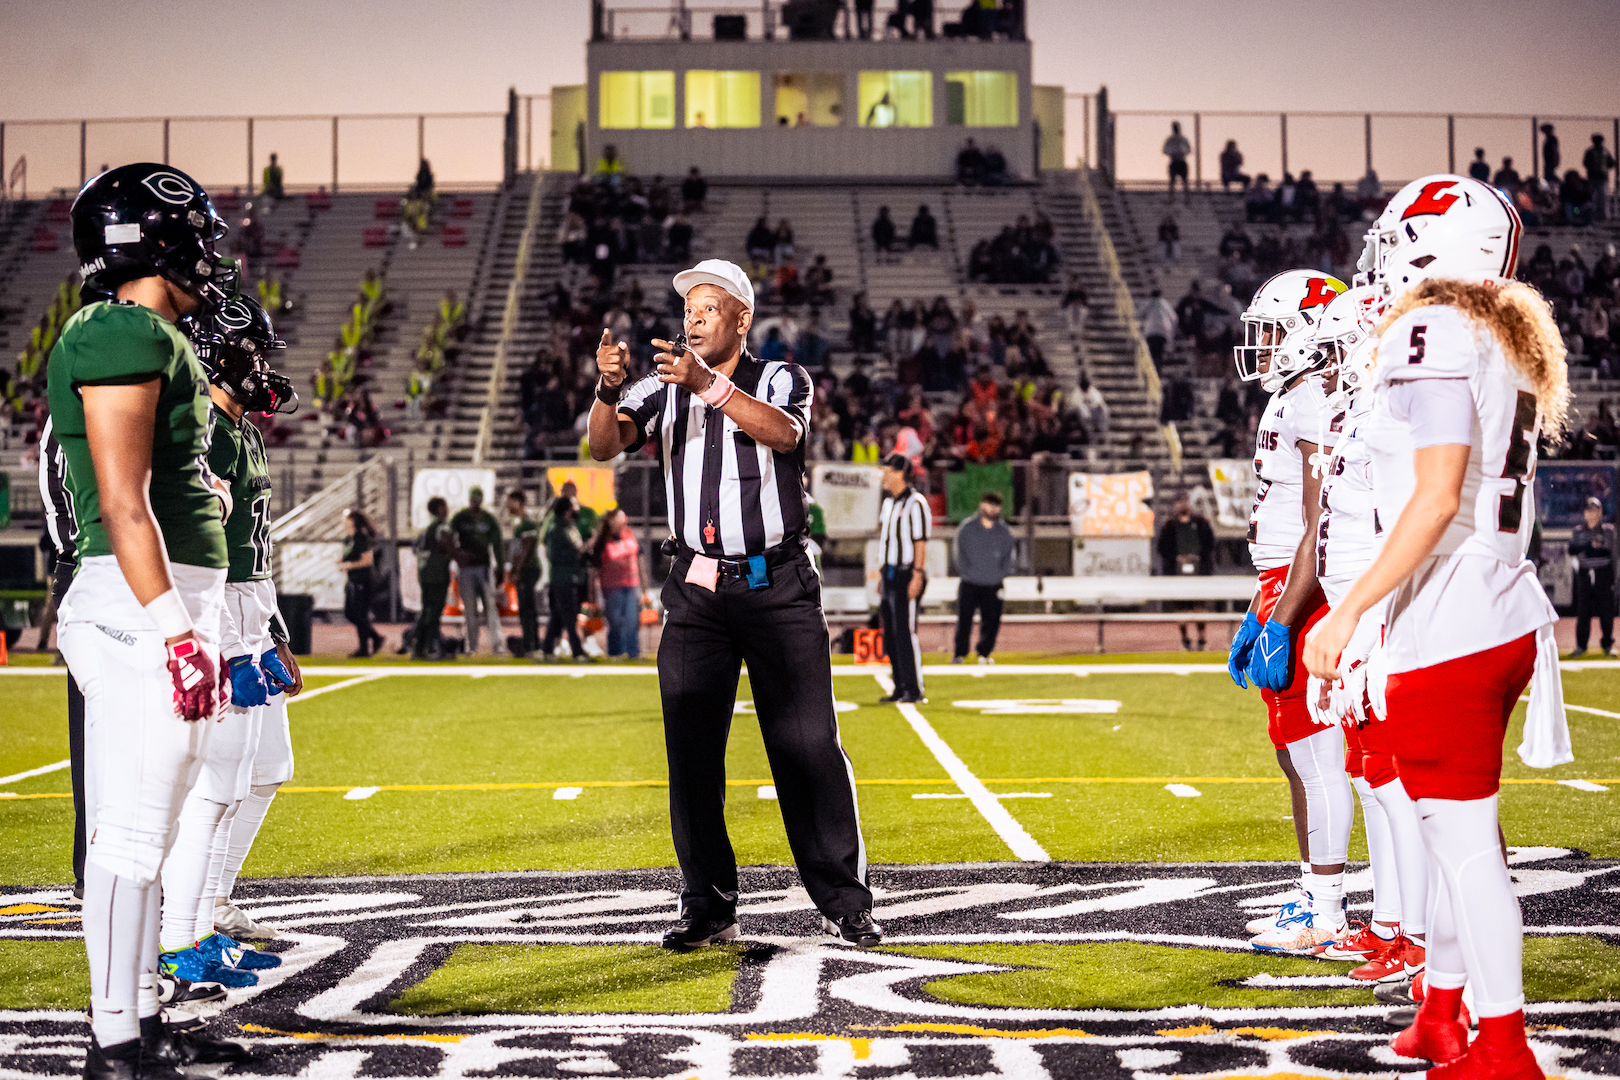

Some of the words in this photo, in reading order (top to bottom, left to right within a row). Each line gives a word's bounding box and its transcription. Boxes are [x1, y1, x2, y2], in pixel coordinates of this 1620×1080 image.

[1408, 325, 1428, 365] 5
[1498, 389, 1537, 534] 5
[859, 632, 884, 660] 50
